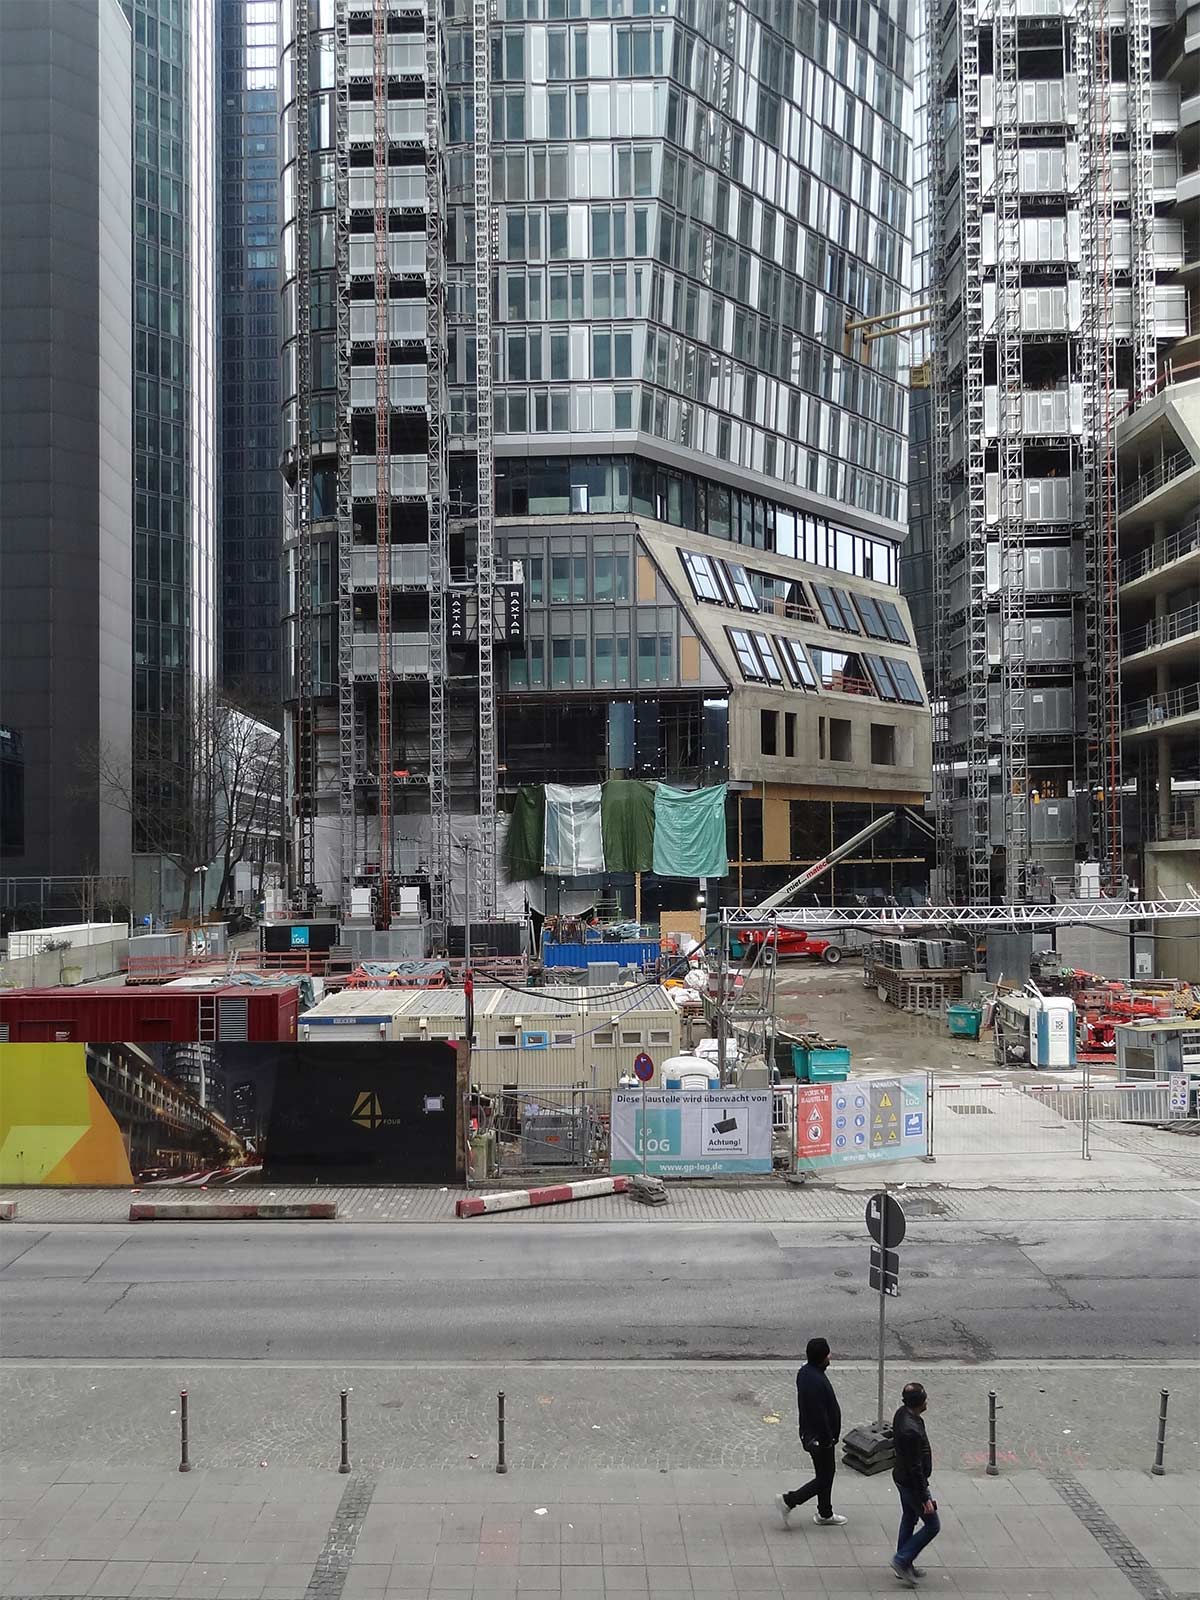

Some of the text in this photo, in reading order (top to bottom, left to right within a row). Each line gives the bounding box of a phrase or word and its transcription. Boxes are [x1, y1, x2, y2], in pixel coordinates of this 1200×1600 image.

[511, 591, 520, 635] RAXTAR
[617, 1094, 640, 1103] Diese
[683, 1094, 702, 1103] wird
[704, 1094, 750, 1103] überwacht
[708, 1139, 741, 1147] Achtung!
[659, 1163, 723, 1173] www.gp-log.de
